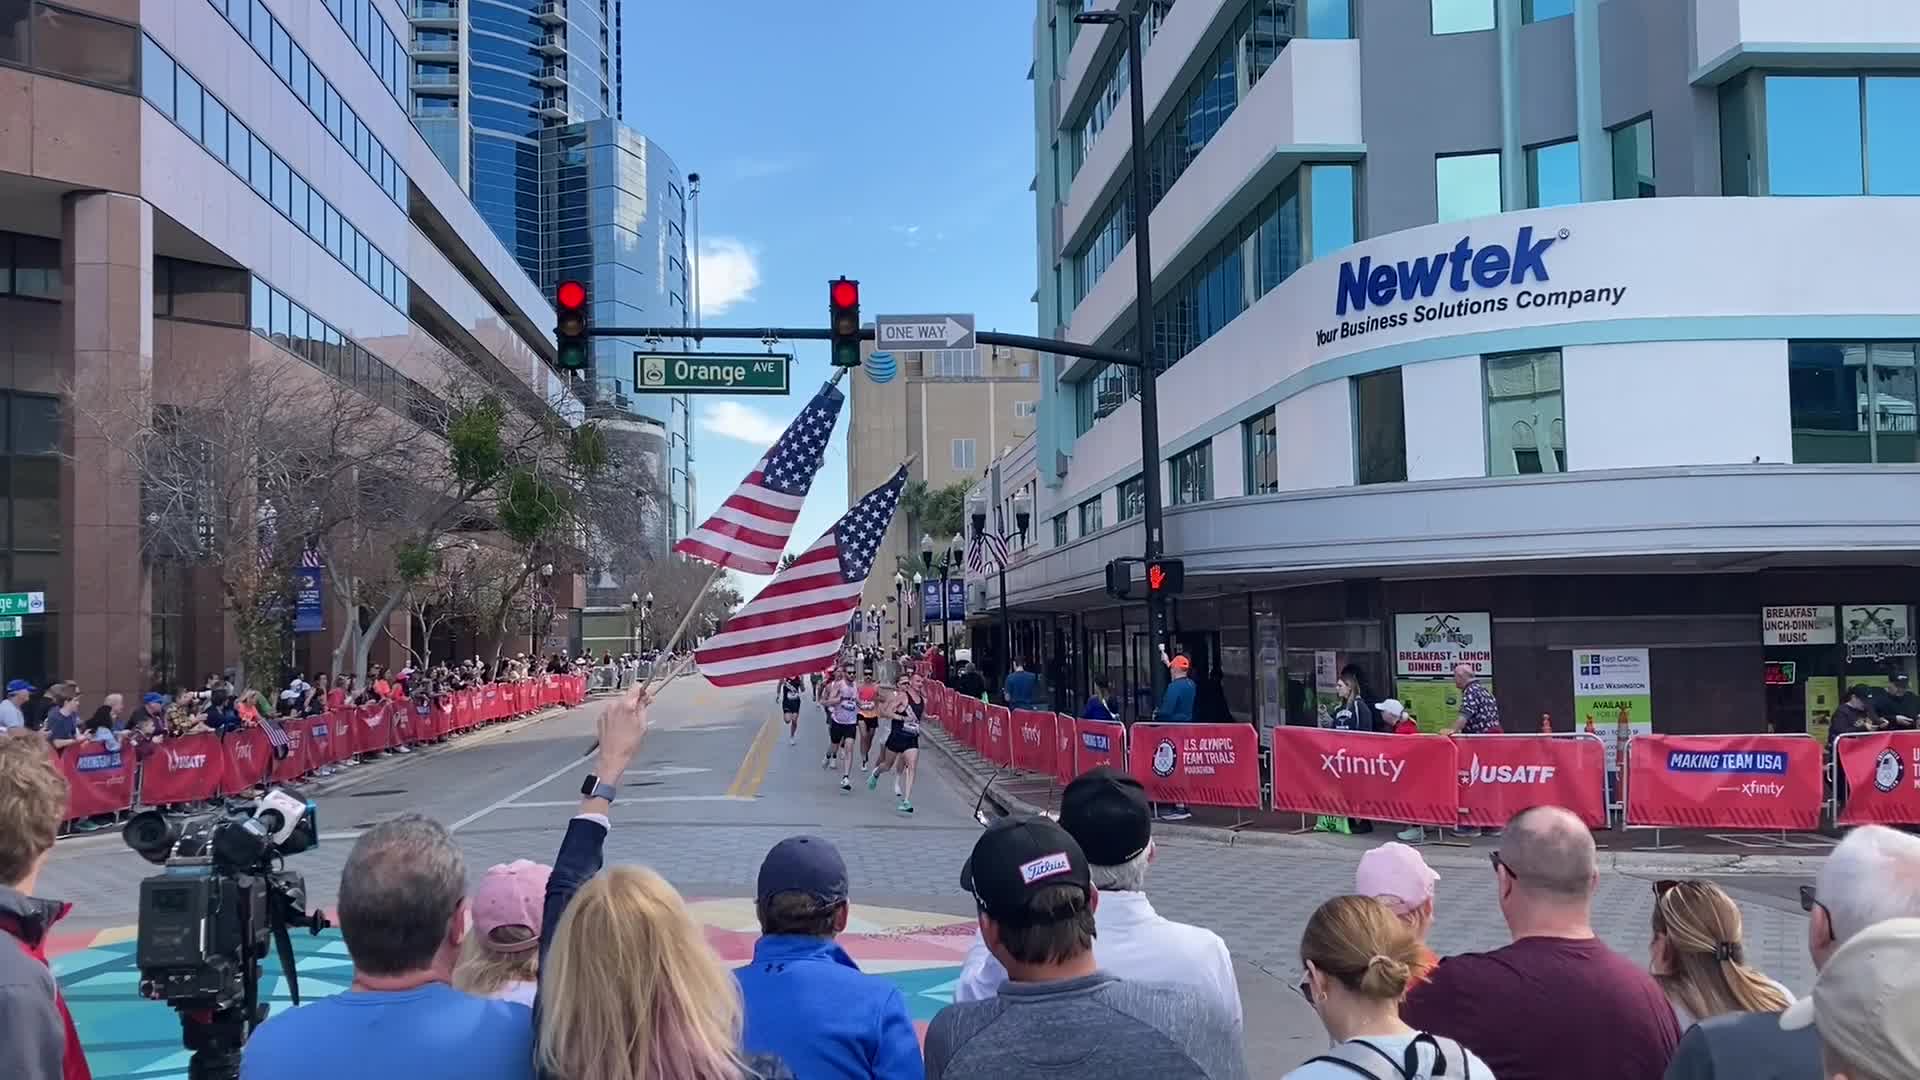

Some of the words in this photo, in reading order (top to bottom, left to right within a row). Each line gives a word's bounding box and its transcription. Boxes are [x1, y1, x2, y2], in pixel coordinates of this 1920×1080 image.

[1335, 226, 1556, 316] Newtek
[1316, 327, 1338, 346] Your
[1340, 312, 1407, 338] Business
[1413, 295, 1508, 322] Solutions
[1516, 286, 1627, 309] Company
[885, 325, 913, 340] ONE
[916, 325, 946, 340] WAY
[674, 360, 746, 384] Orange
[752, 362, 775, 374] AVE
[1766, 608, 1818, 618] BREAKFAST
[1778, 632, 1808, 643] MUSIC
[1399, 651, 1451, 661] BREAKFAST
[1459, 651, 1490, 661] LUNCH
[1408, 662, 1442, 672] DINNER
[1450, 662, 1482, 672] MIC
[1199, 738, 1234, 750] OLYMPIC
[1182, 752, 1204, 764] TEAM
[1205, 751, 1235, 764] TRIALS
[1320, 748, 1405, 782] xfinity
[1670, 753, 1719, 769] MAKING
[1721, 753, 1753, 769] TEAM
[1756, 753, 1783, 770] USA
[1480, 765, 1556, 784] USATF
[1742, 779, 1784, 798] xfinity
